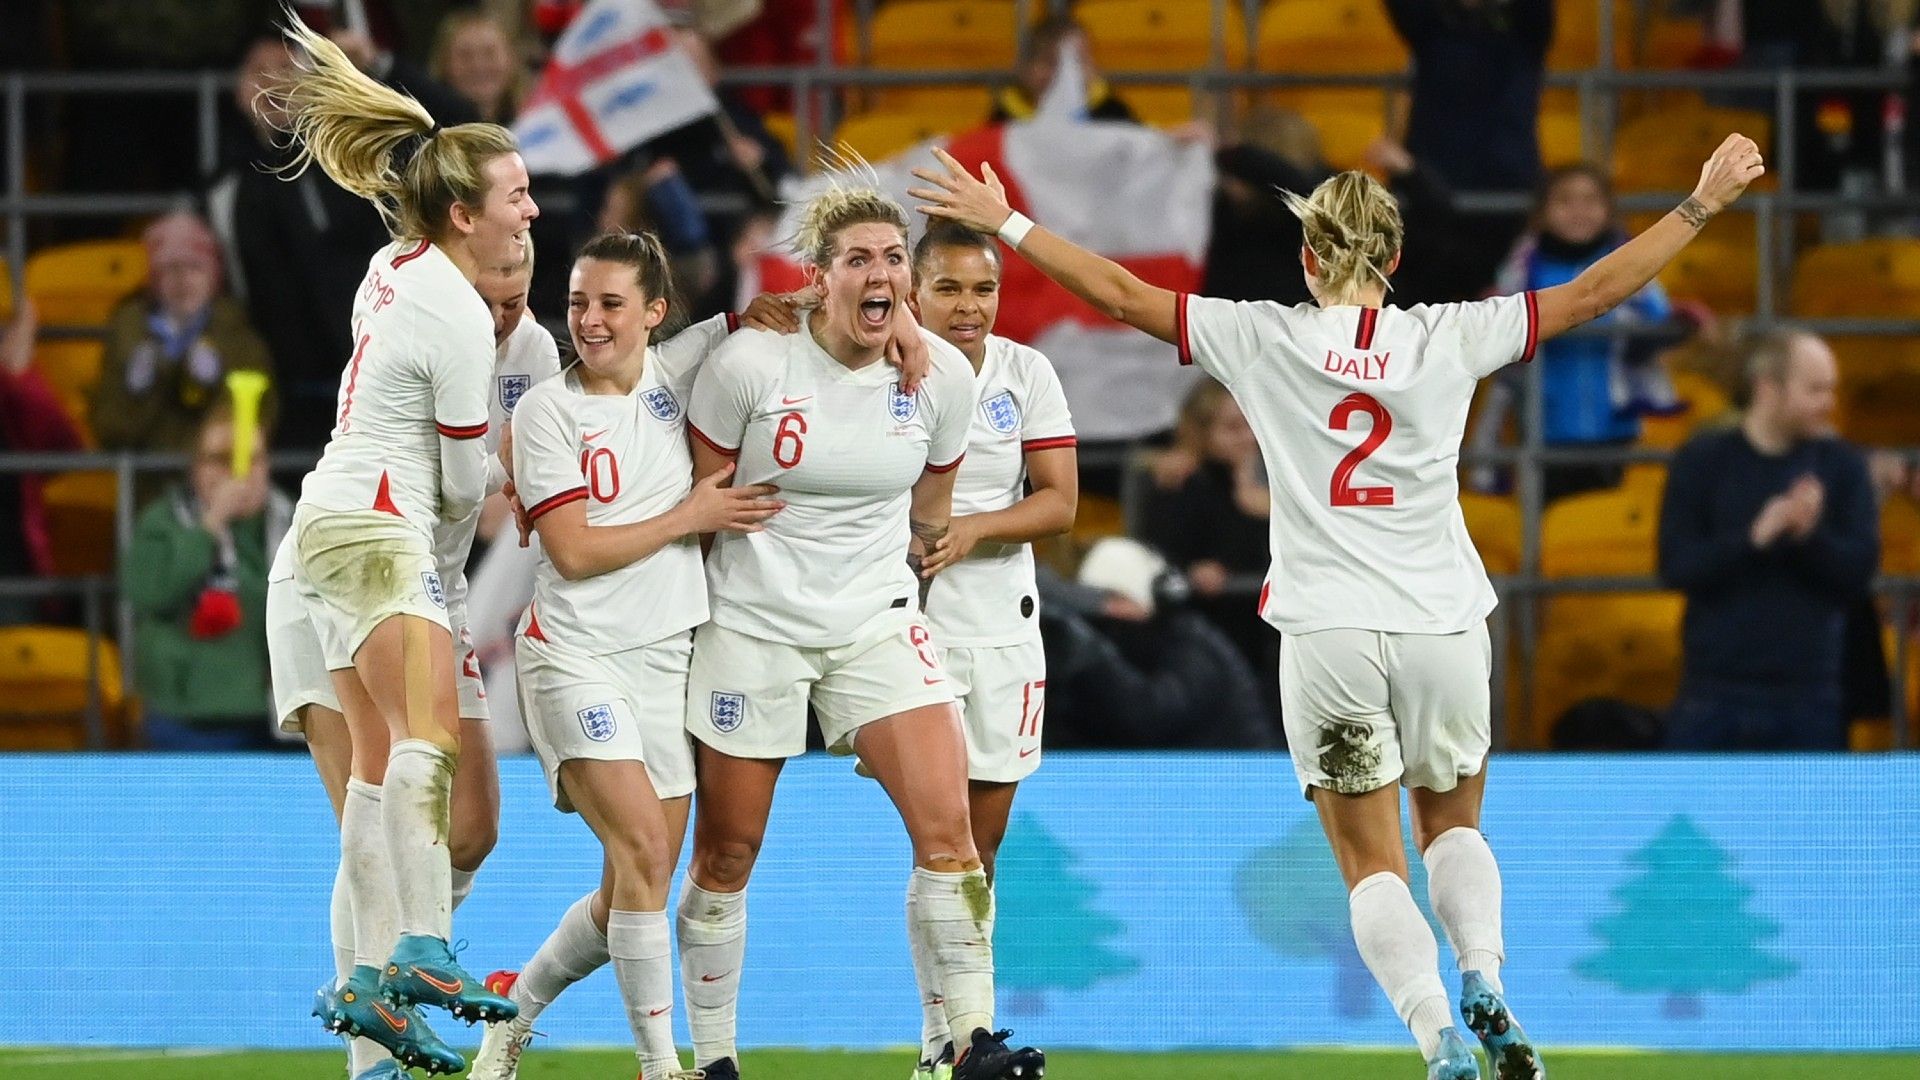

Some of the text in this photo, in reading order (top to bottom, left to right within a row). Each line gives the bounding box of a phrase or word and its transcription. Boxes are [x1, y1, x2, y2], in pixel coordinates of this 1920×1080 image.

[1324, 350, 1390, 380] DALY
[773, 412, 807, 469] 6
[1328, 392, 1394, 507] 2
[581, 447, 620, 503] 10
[1018, 680, 1046, 736] 17
